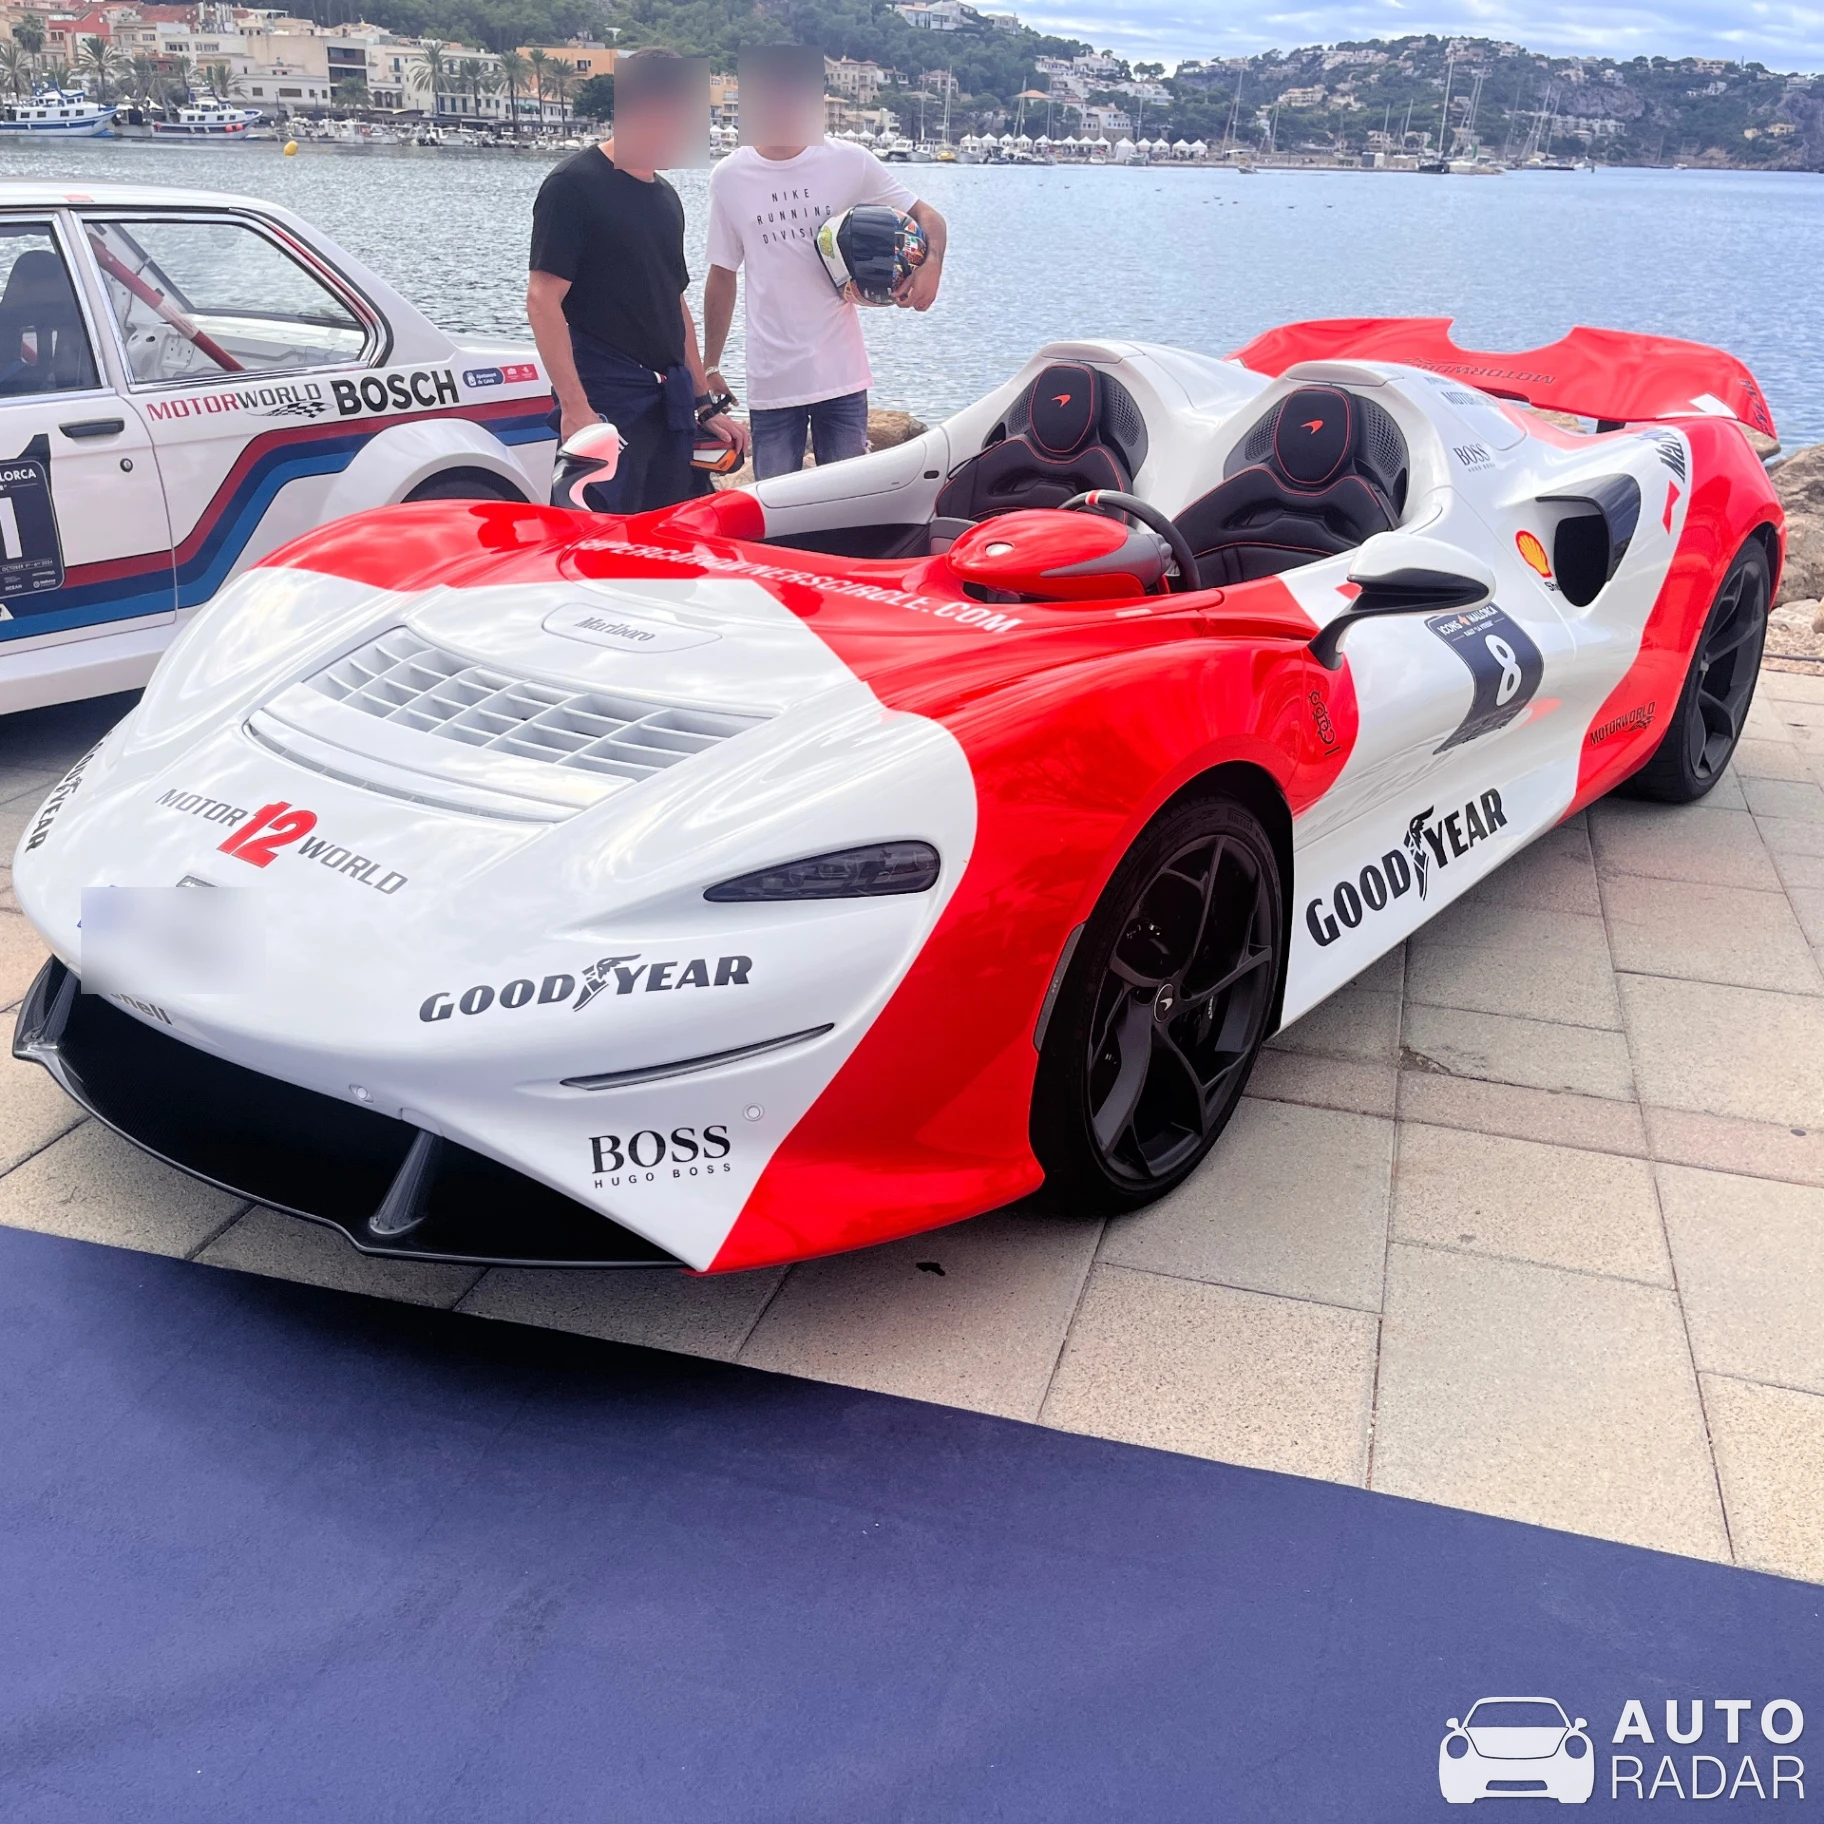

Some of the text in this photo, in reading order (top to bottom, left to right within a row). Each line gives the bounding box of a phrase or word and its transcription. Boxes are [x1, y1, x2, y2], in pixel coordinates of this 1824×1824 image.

[772, 188, 810, 202] NIKE
[756, 205, 831, 225] RUNNING
[763, 226, 821, 244] DIVISI
[146, 383, 322, 422] MOTORWORLD
[329, 369, 460, 417] BOSCH
[1453, 443, 1490, 466] BOSS
[573, 616, 656, 642] Marlboro
[1437, 620, 1463, 635] ICONS
[1466, 606, 1498, 623] MALLORCA
[1484, 634, 1522, 707] 8
[1589, 701, 1656, 747] MOTORWORLD
[155, 788, 409, 896] MOTOR 12 WORLD
[588, 1125, 731, 1176] BOSS
[594, 1162, 731, 1189] HUGO BOSS
